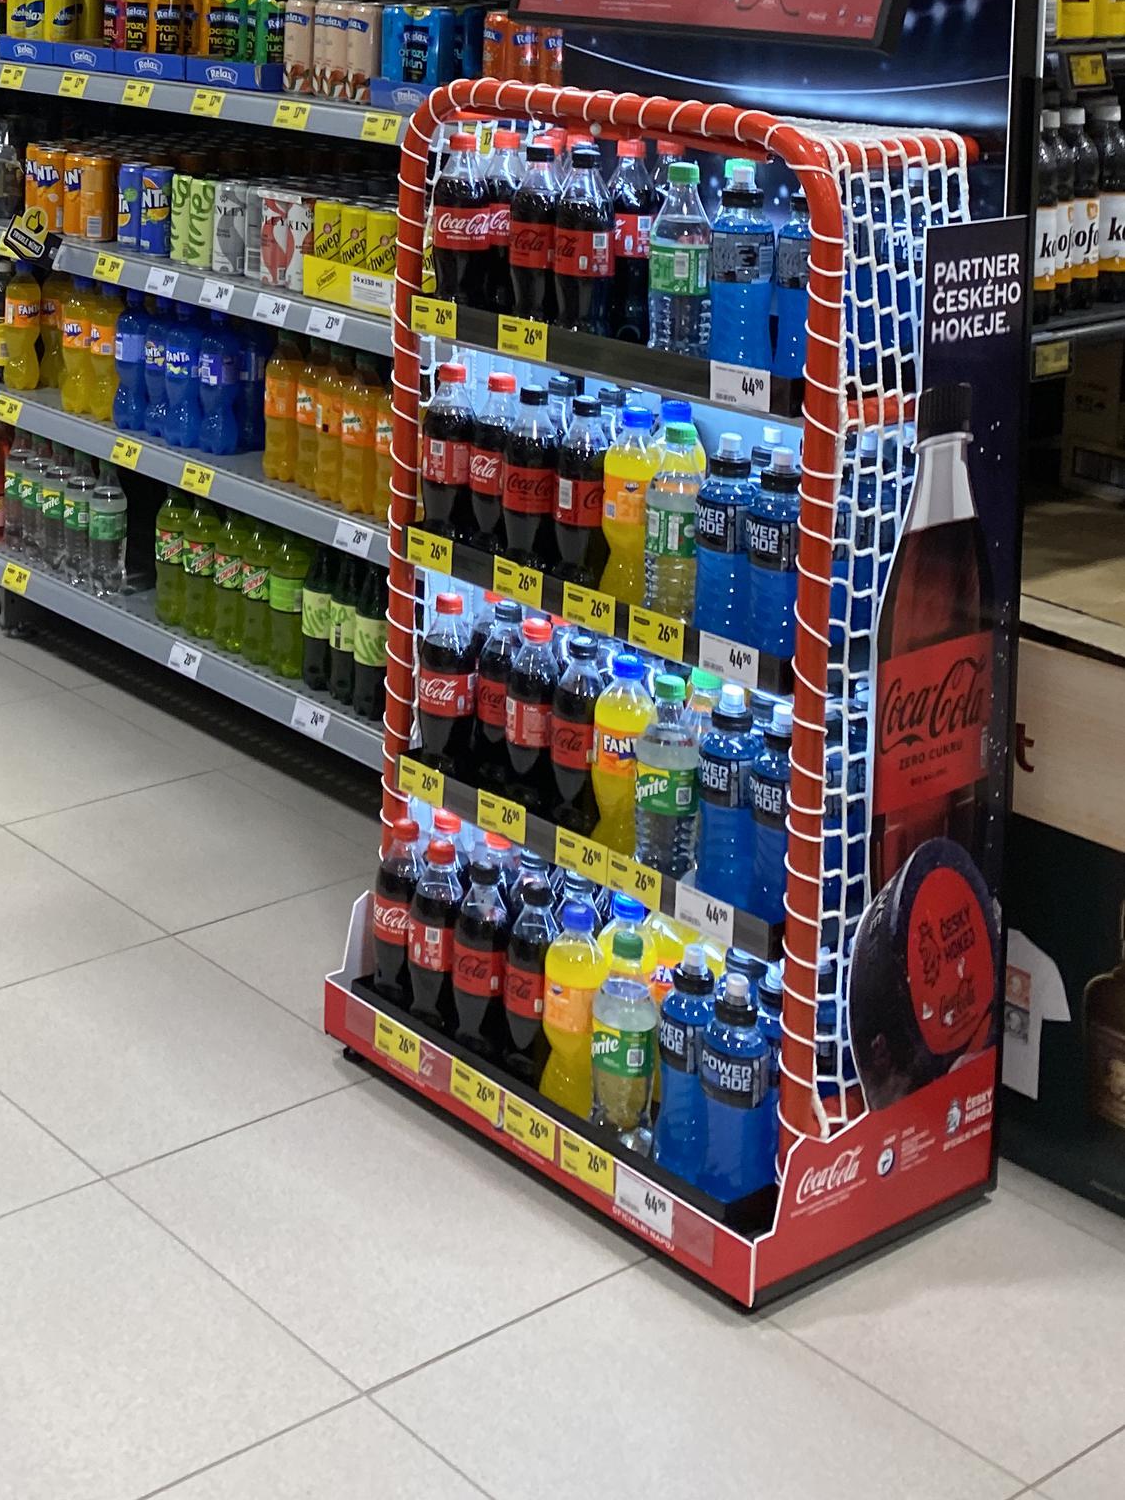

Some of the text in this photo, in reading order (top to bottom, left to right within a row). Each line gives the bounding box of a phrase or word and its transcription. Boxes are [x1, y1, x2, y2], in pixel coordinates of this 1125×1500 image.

[37, 165, 59, 180] NTA
[143, 188, 169, 208] NTA
[217, 207, 245, 217] NLEY
[934, 253, 1020, 285] PARTNER
[931, 278, 1022, 316] ČESKÉHO
[63, 323, 82, 336] ANTA
[931, 310, 1010, 344] HOKEJE.
[746, 519, 779, 539] OWER
[878, 654, 987, 755] Coca-Cola
[899, 740, 963, 771] ZERO CUKRU
[749, 776, 782, 800] OWER
[591, 1035, 619, 1058] prite
[702, 1050, 752, 1078] POWER
[795, 1145, 865, 1204] Coca-Cola
